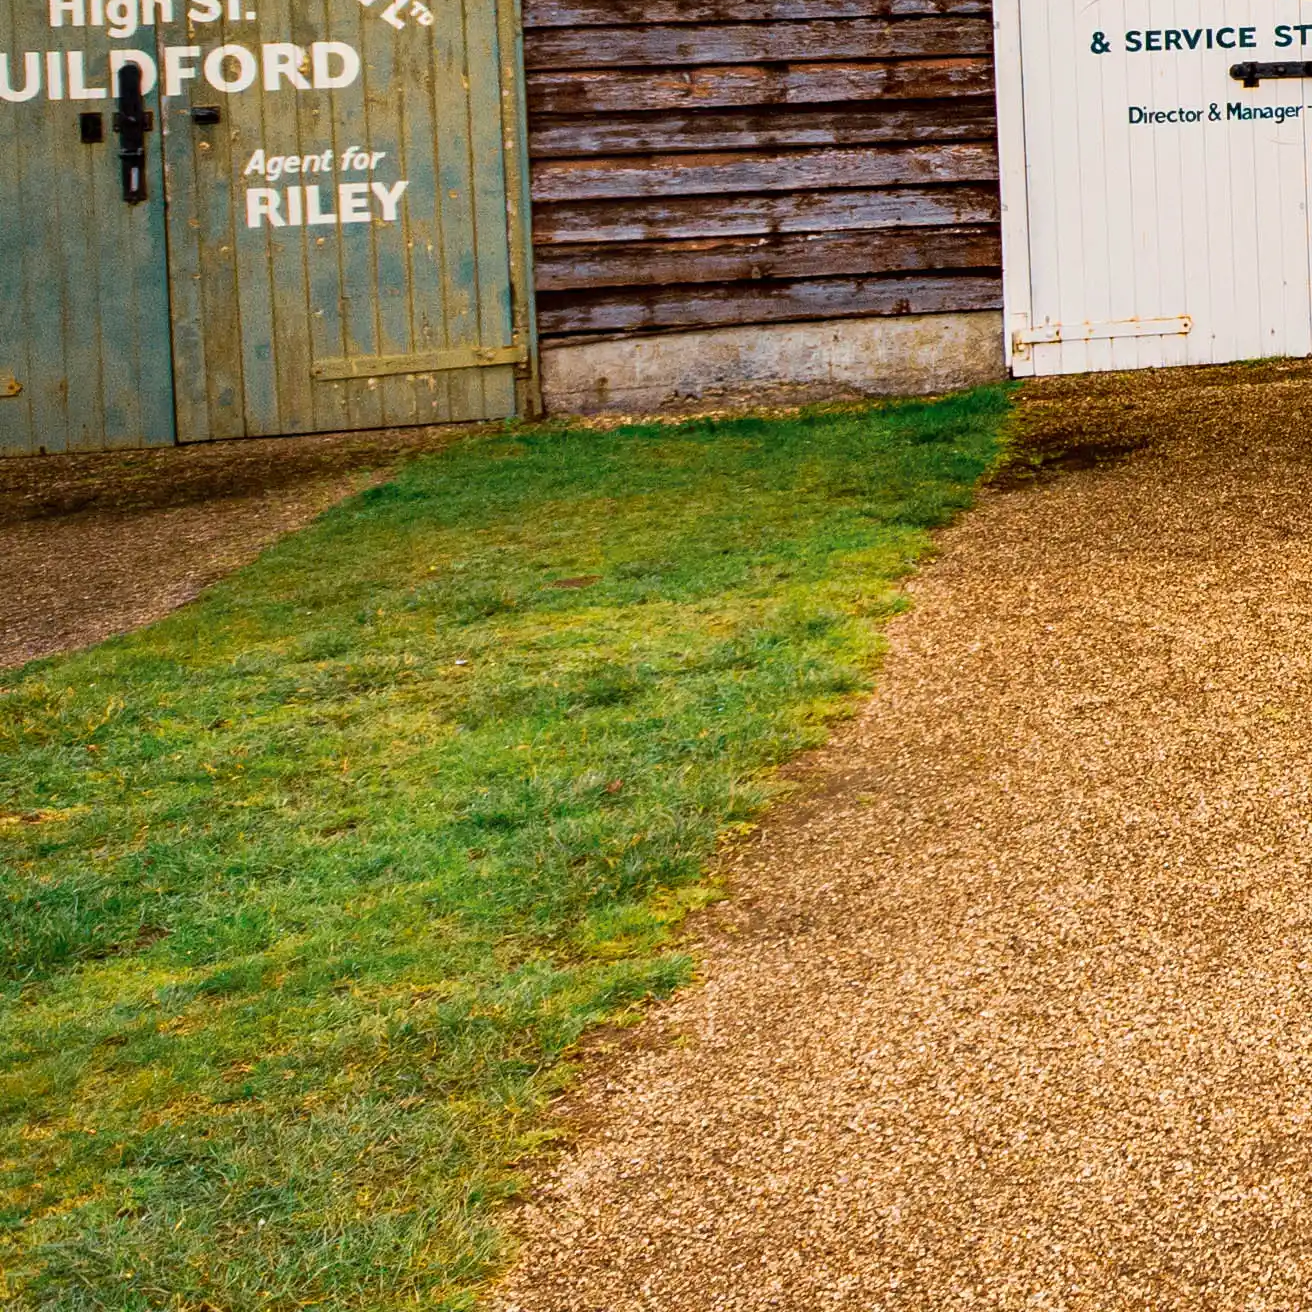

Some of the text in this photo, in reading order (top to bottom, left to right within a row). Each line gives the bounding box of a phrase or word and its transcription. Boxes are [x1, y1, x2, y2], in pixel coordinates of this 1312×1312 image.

[1090, 31, 1112, 55] &
[1125, 26, 1257, 53] SERVICE
[1128, 106, 1205, 124] Director
[1207, 102, 1222, 122] &
[1226, 102, 1304, 125] Manager
[244, 145, 386, 178] Agent for
[246, 181, 410, 229] RILEY
